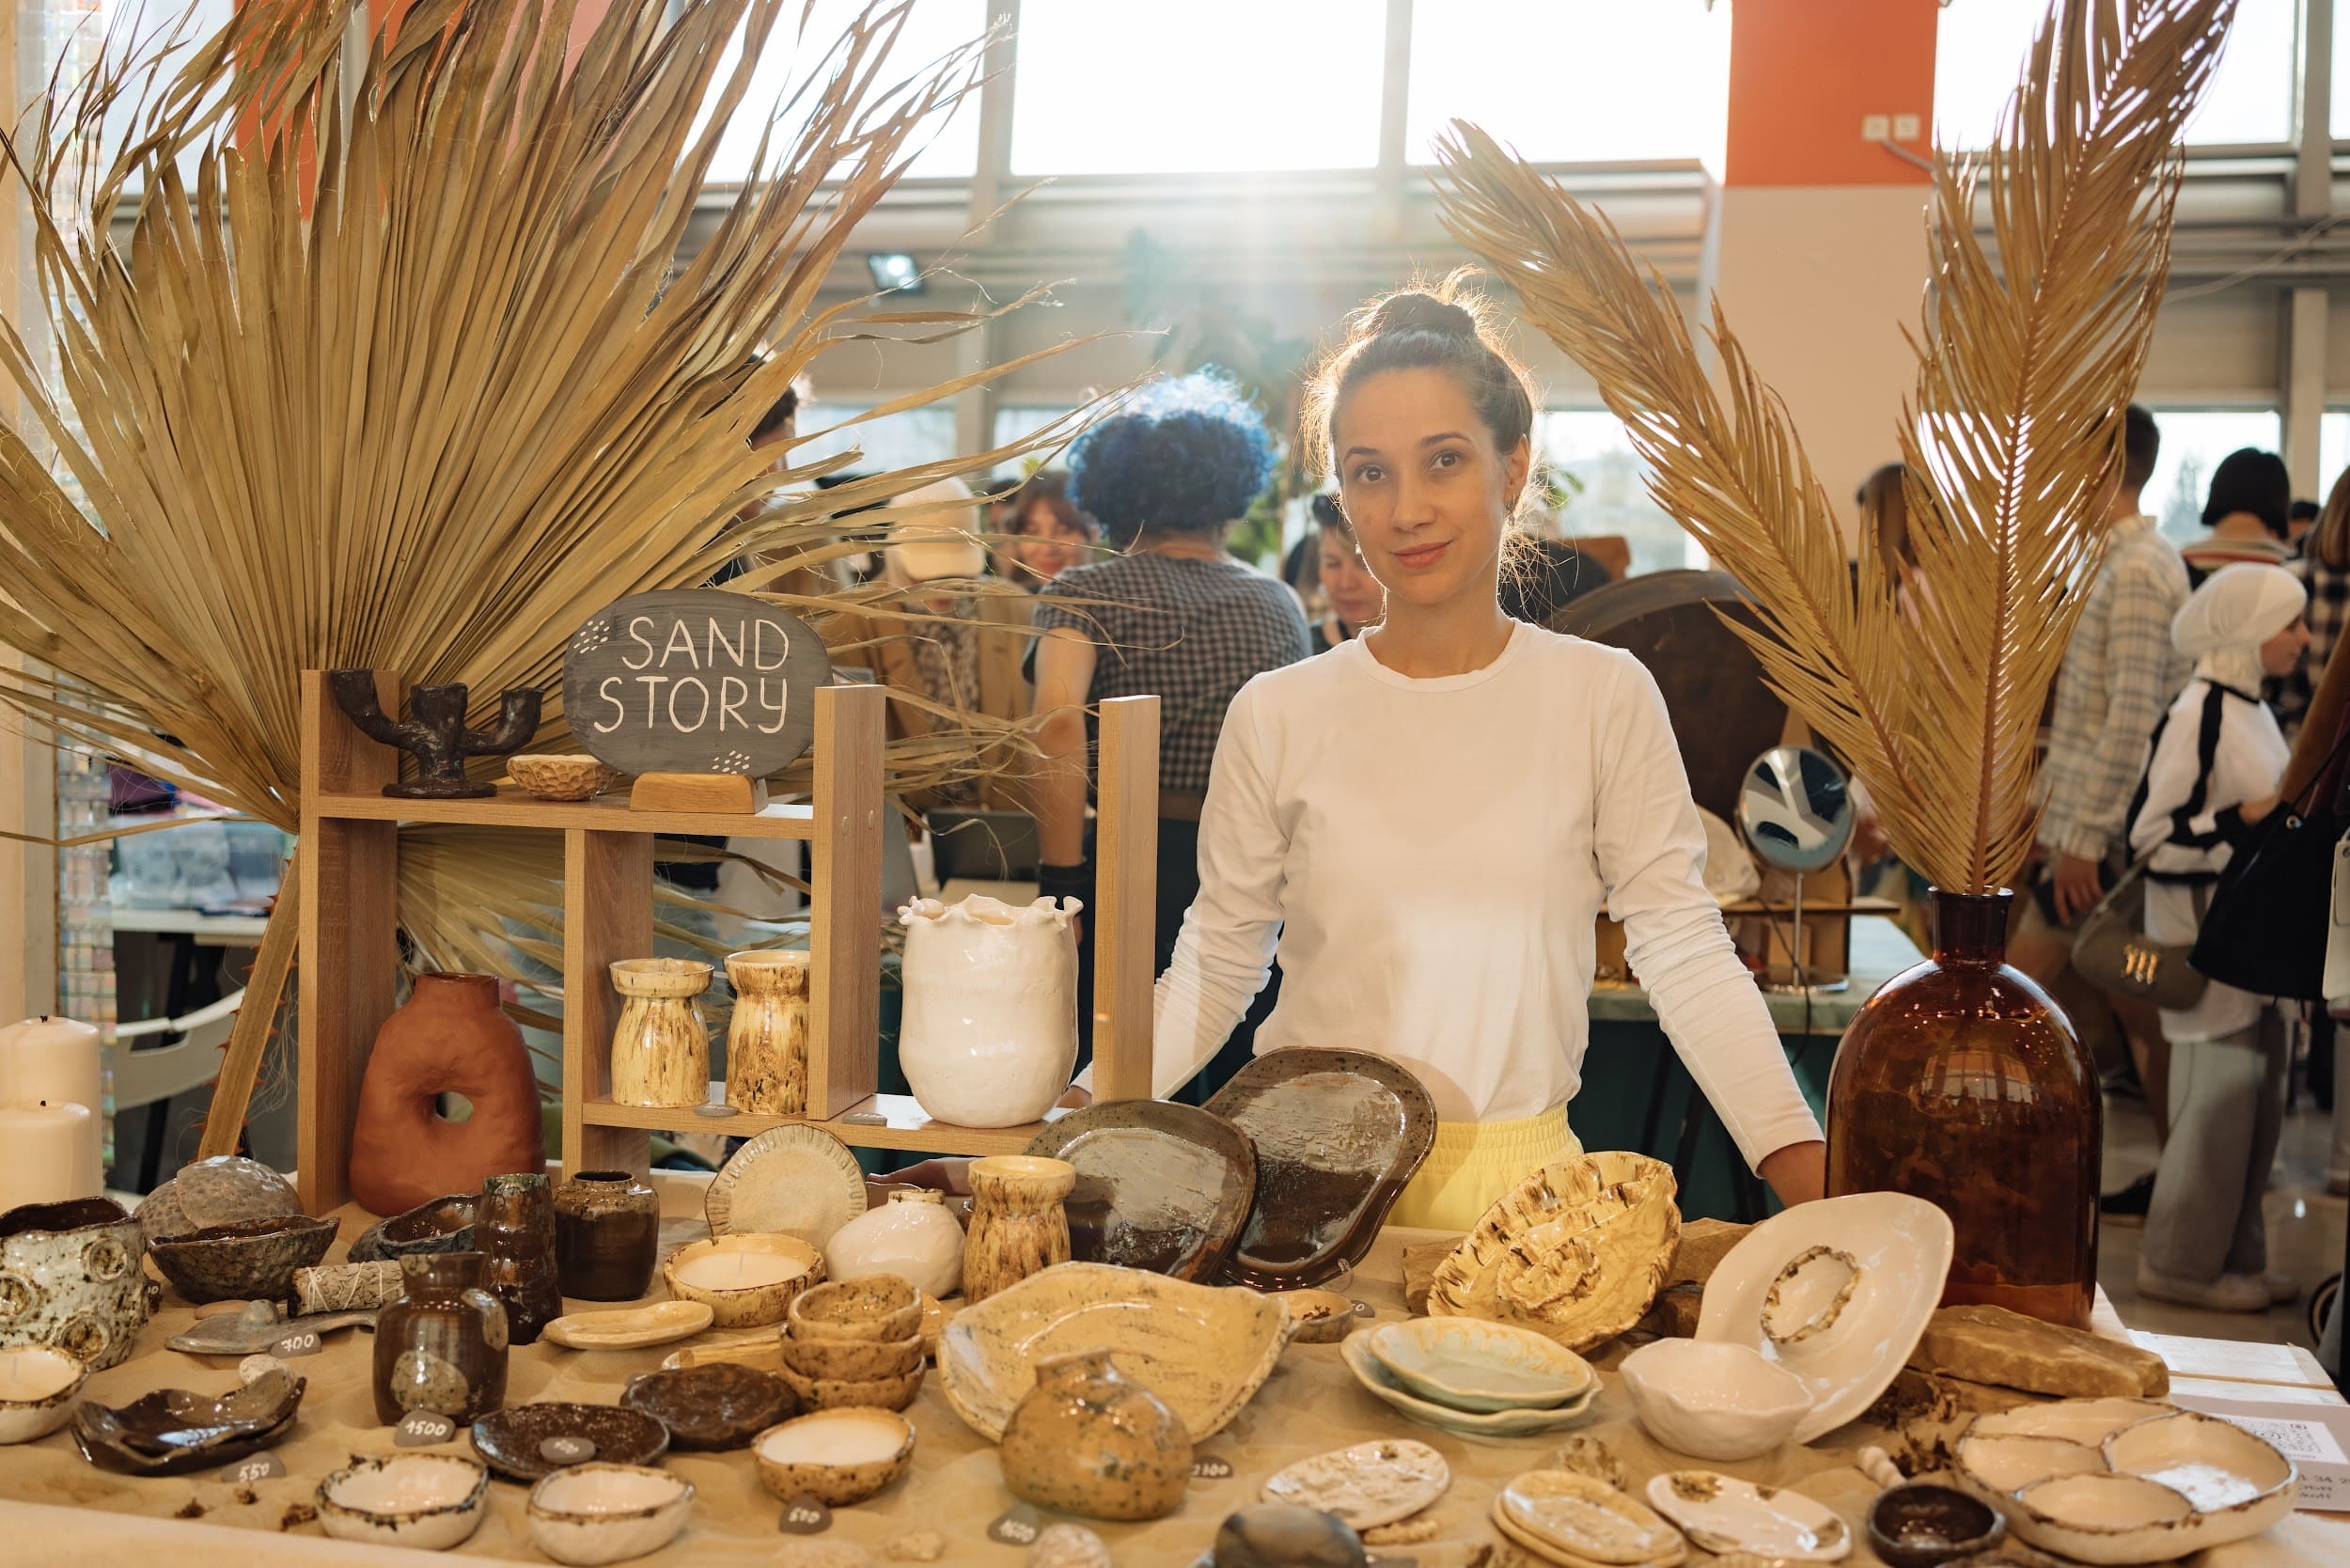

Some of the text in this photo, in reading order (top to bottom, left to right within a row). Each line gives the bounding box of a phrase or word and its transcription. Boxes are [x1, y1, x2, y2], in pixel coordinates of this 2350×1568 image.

[621, 616, 789, 670] SAND
[593, 676, 788, 734] STORY
[281, 1334, 314, 1352] 700
[405, 1420, 447, 1436] 1500
[239, 1462, 270, 1482] 550
